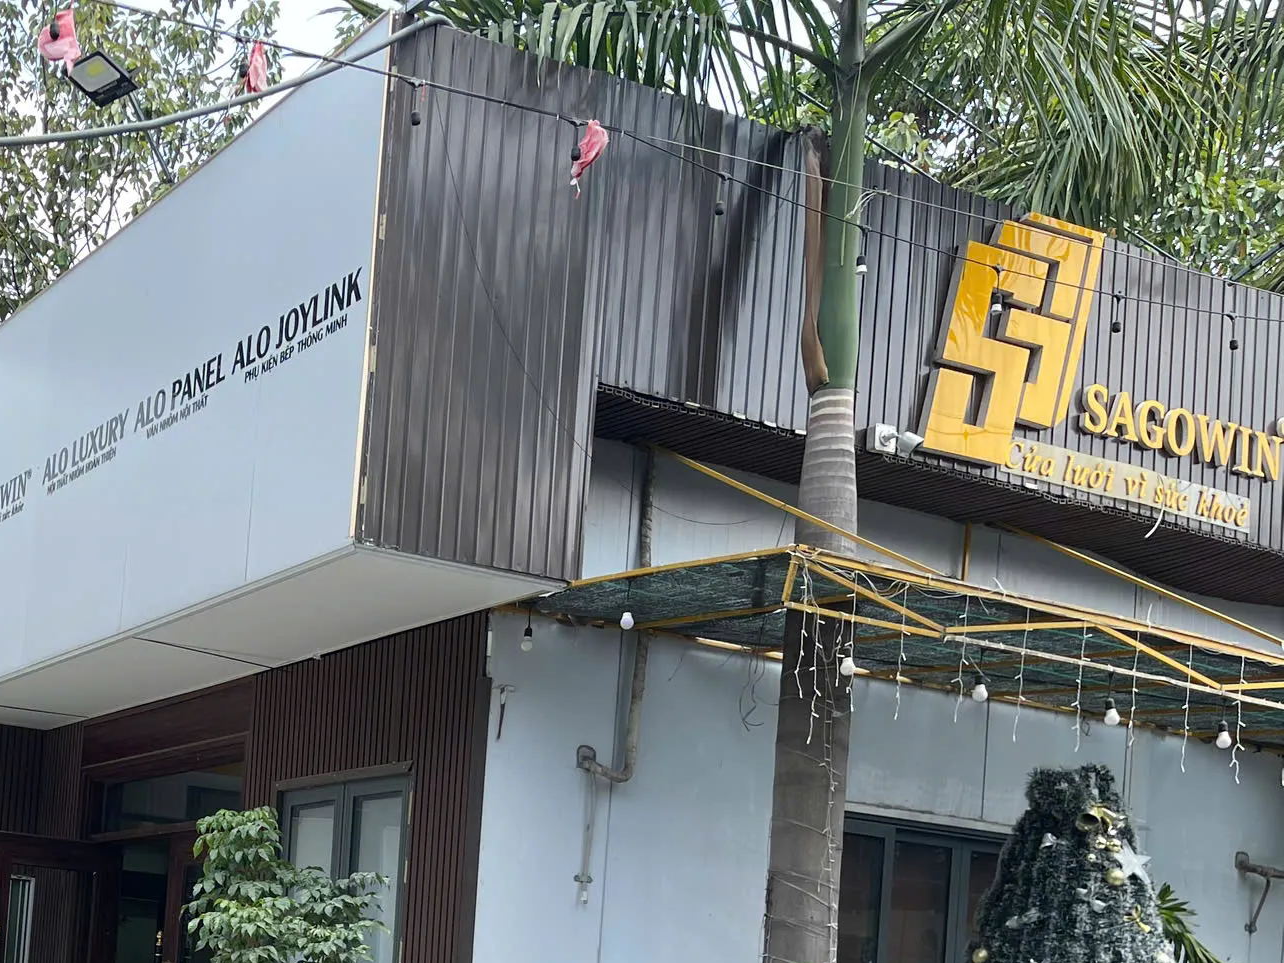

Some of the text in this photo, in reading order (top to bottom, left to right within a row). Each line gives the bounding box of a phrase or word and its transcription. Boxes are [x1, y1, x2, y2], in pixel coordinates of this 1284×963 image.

[325, 313, 347, 337] MINH
[42, 447, 69, 485] ALO
[71, 408, 129, 467] LUXURY
[134, 389, 166, 433] ALO
[170, 353, 225, 411] PANEL
[231, 325, 271, 375] ALO
[276, 266, 362, 349] JOYLINK
[1124, 470, 1148, 499] vì
